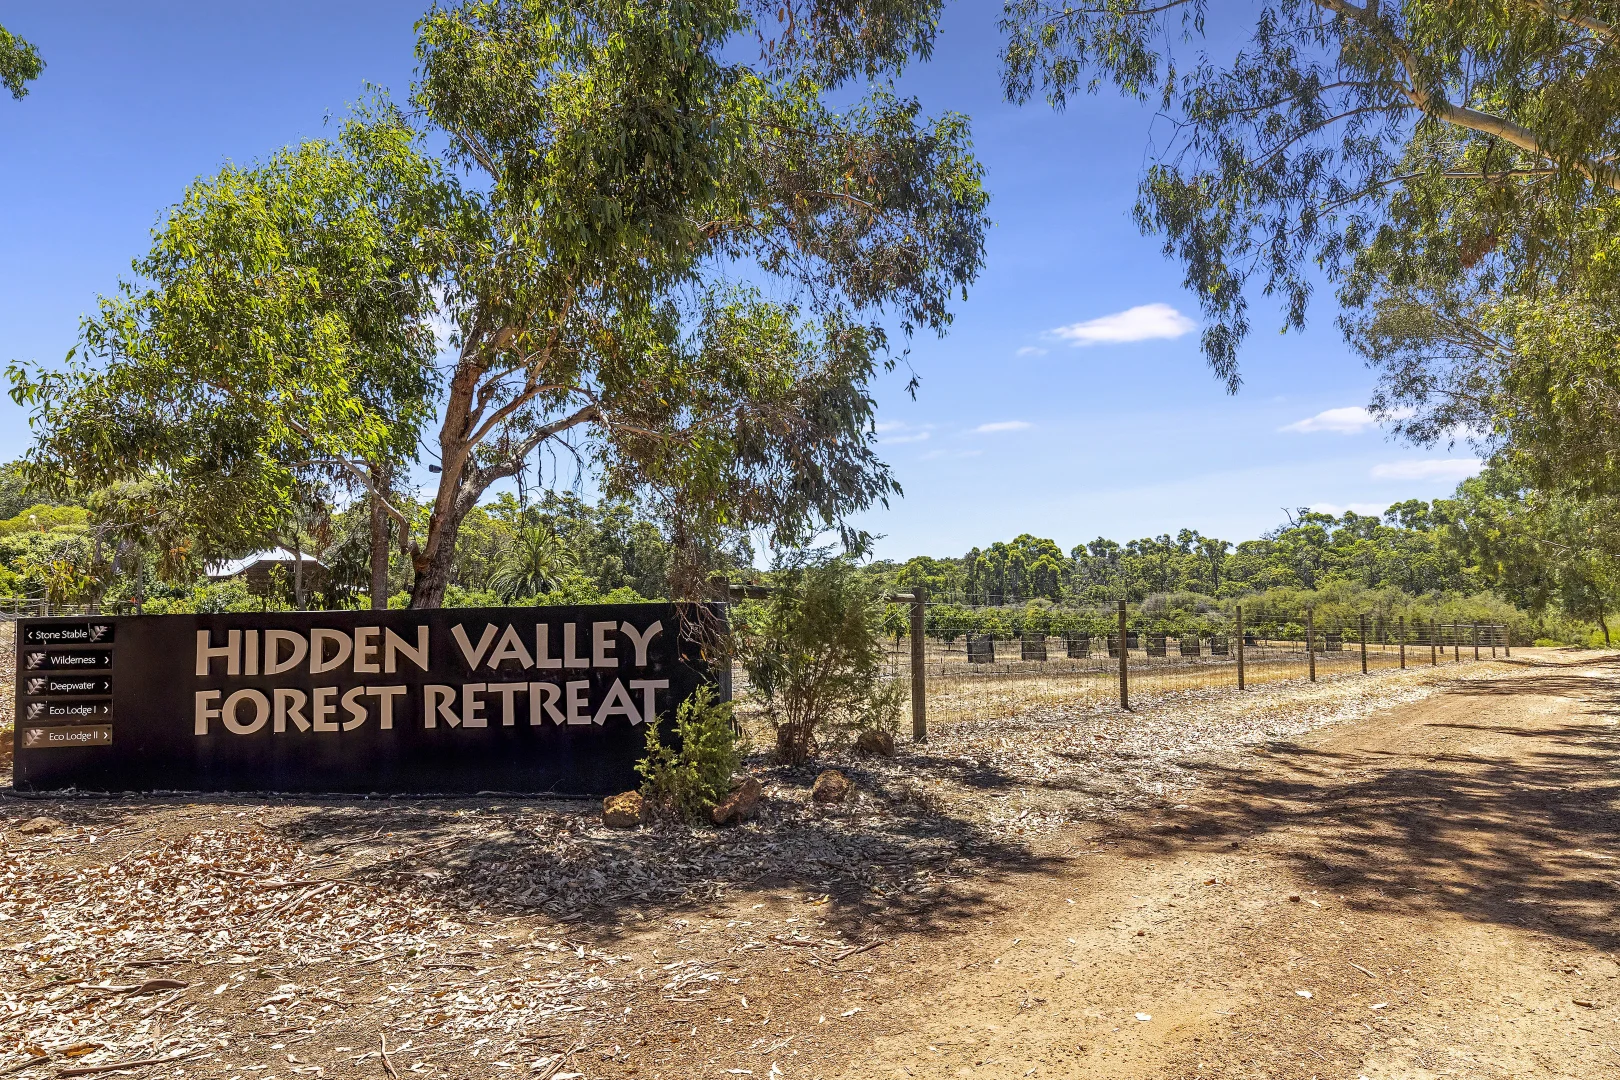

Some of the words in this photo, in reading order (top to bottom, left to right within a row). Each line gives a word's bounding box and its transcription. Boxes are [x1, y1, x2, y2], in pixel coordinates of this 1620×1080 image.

[36, 631, 60, 640] Stone
[62, 630, 88, 639] Stable
[195, 625, 429, 676] HIDDEN
[451, 620, 663, 670] VALLEY
[50, 656, 96, 665] Wilderness
[50, 682, 96, 692] Deepwater
[49, 706, 65, 715] Eco
[66, 705, 92, 716] Lodge
[195, 685, 407, 736] FOREST
[424, 679, 669, 729] RETREAT
[49, 732, 65, 741] Eco
[66, 731, 92, 742] Lodge
[93, 731, 98, 739] II
